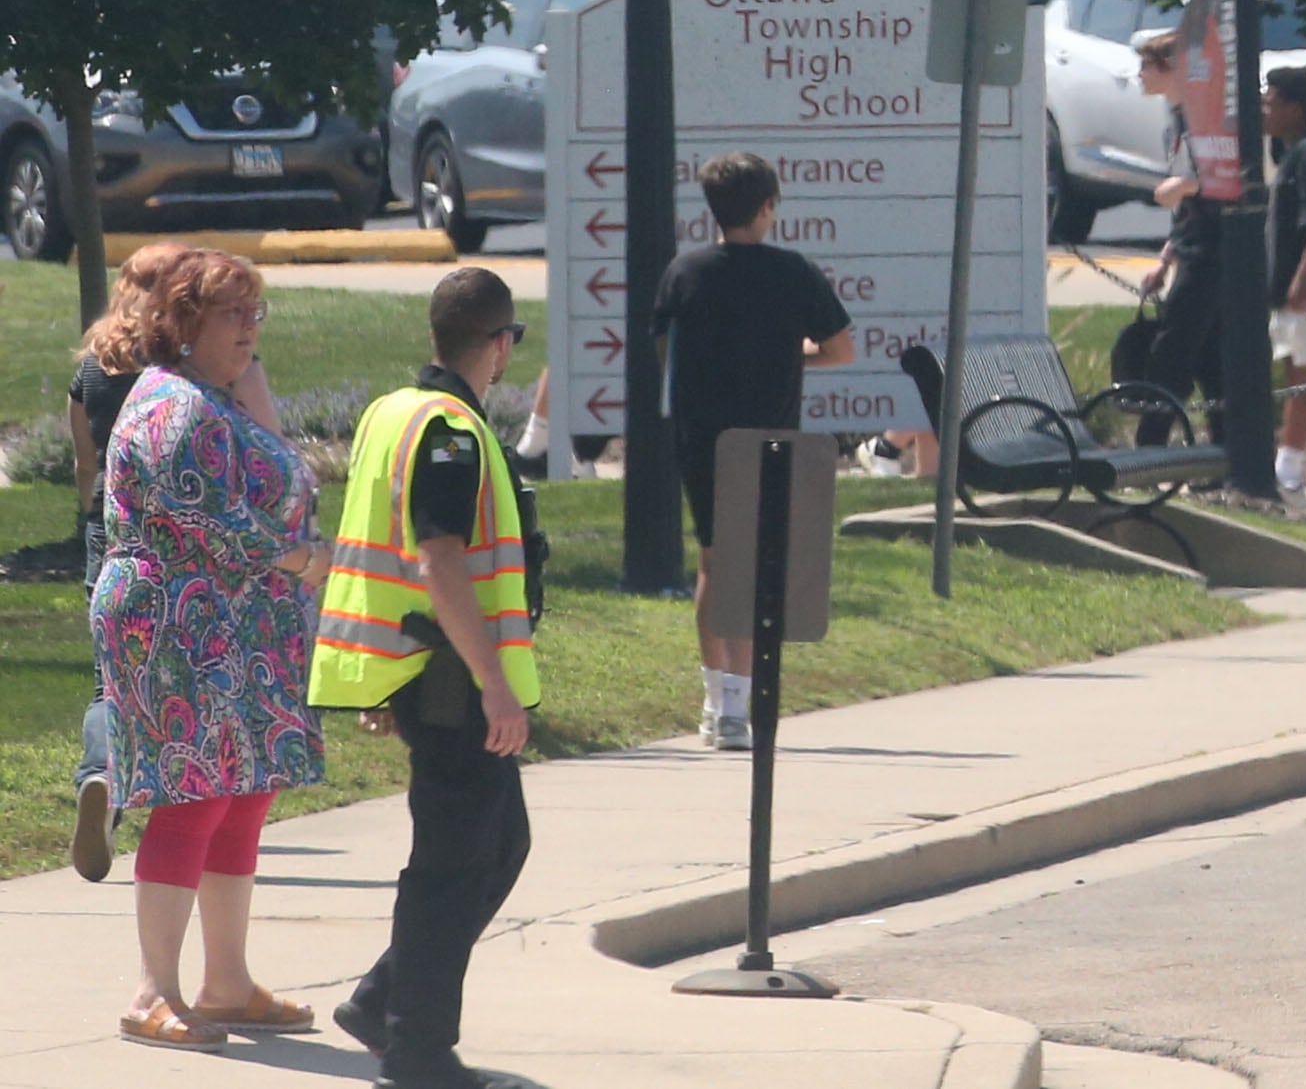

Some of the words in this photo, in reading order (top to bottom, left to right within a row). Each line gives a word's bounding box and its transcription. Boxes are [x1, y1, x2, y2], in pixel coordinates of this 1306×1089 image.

[735, 9, 913, 46] Township
[764, 45, 853, 83] High
[798, 84, 921, 120] School
[778, 154, 885, 184] trance
